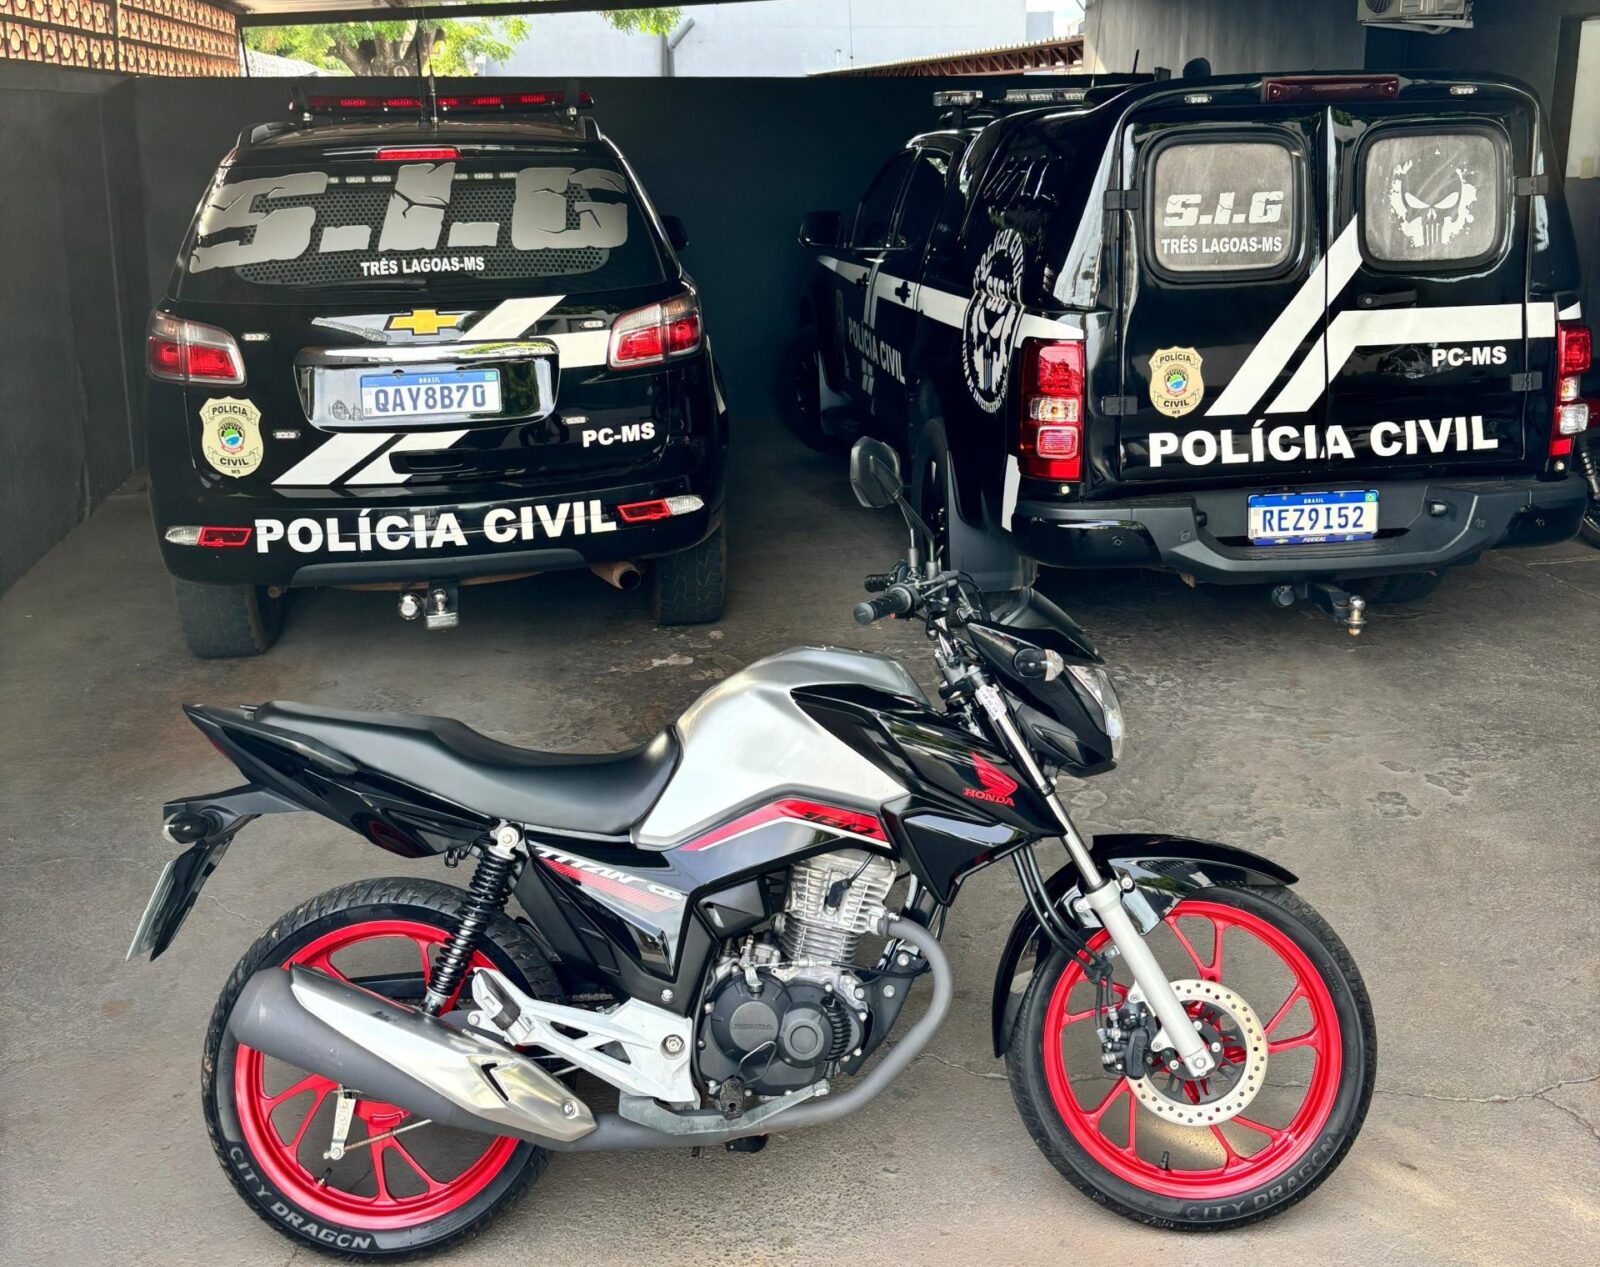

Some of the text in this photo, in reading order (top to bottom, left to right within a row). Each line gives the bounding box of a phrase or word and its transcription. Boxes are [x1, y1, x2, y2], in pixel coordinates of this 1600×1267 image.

[189, 162, 629, 273] S.I.G
[1163, 190, 1285, 227] S.I.G
[1161, 235, 1283, 255] TRÊS LAGOAS-MS
[360, 256, 485, 277] TRÊS LAGOAS-MS
[880, 340, 906, 385] CIVIL
[1159, 353, 1192, 364] POLÍCIA
[1431, 346, 1508, 368] PC-MS
[418, 376, 441, 384] BRASIL
[374, 384, 487, 413] QAY8B70
[1163, 399, 1190, 408] CIVIL
[582, 422, 656, 447] PC-MS
[1149, 415, 1499, 468] POLÍCIA CIVIL
[219, 457, 249, 467] CIVIL
[254, 499, 618, 554] POLÍCIA CIVIL
[1262, 506, 1364, 533] REZ9I52
[963, 788, 1015, 807] HONDA
[535, 846, 647, 884] TITAN
[1186, 1136, 1336, 1221] CITY DRAGON
[229, 1147, 273, 1198] CITY
[270, 1201, 372, 1250] DRAGON
